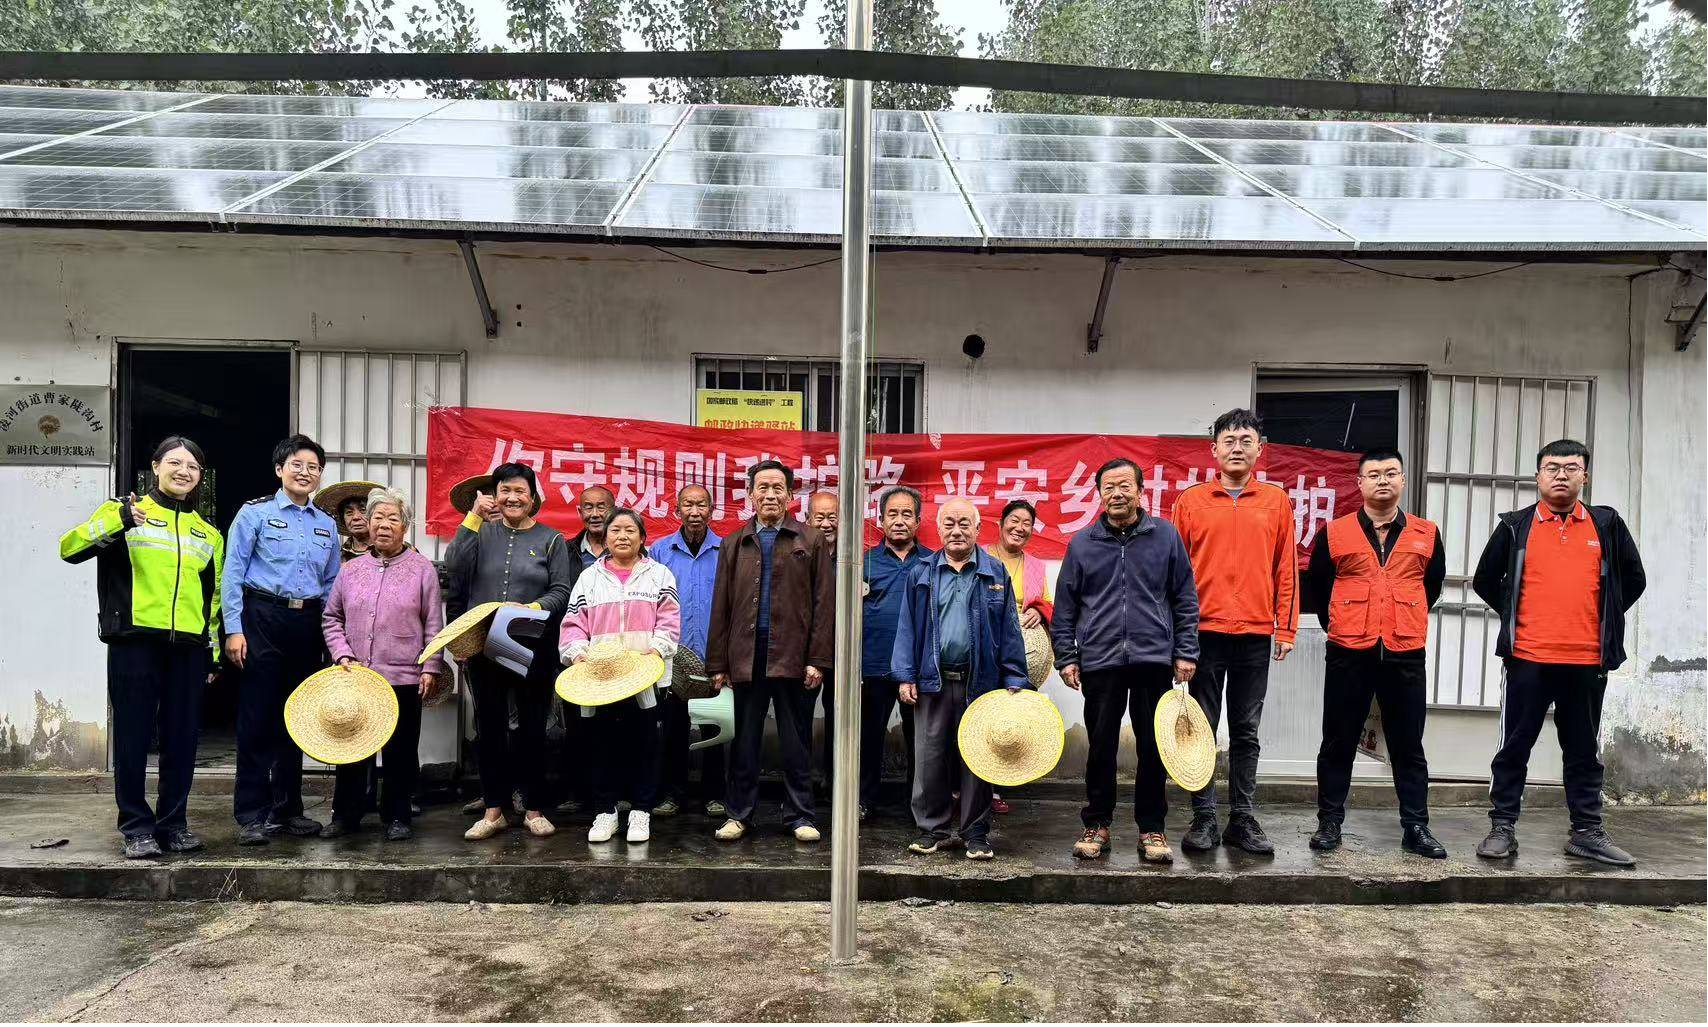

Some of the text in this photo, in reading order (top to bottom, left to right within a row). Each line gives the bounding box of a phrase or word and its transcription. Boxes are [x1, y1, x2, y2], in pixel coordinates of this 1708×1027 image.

[7, 444, 95, 456] 新时代文明实践站
